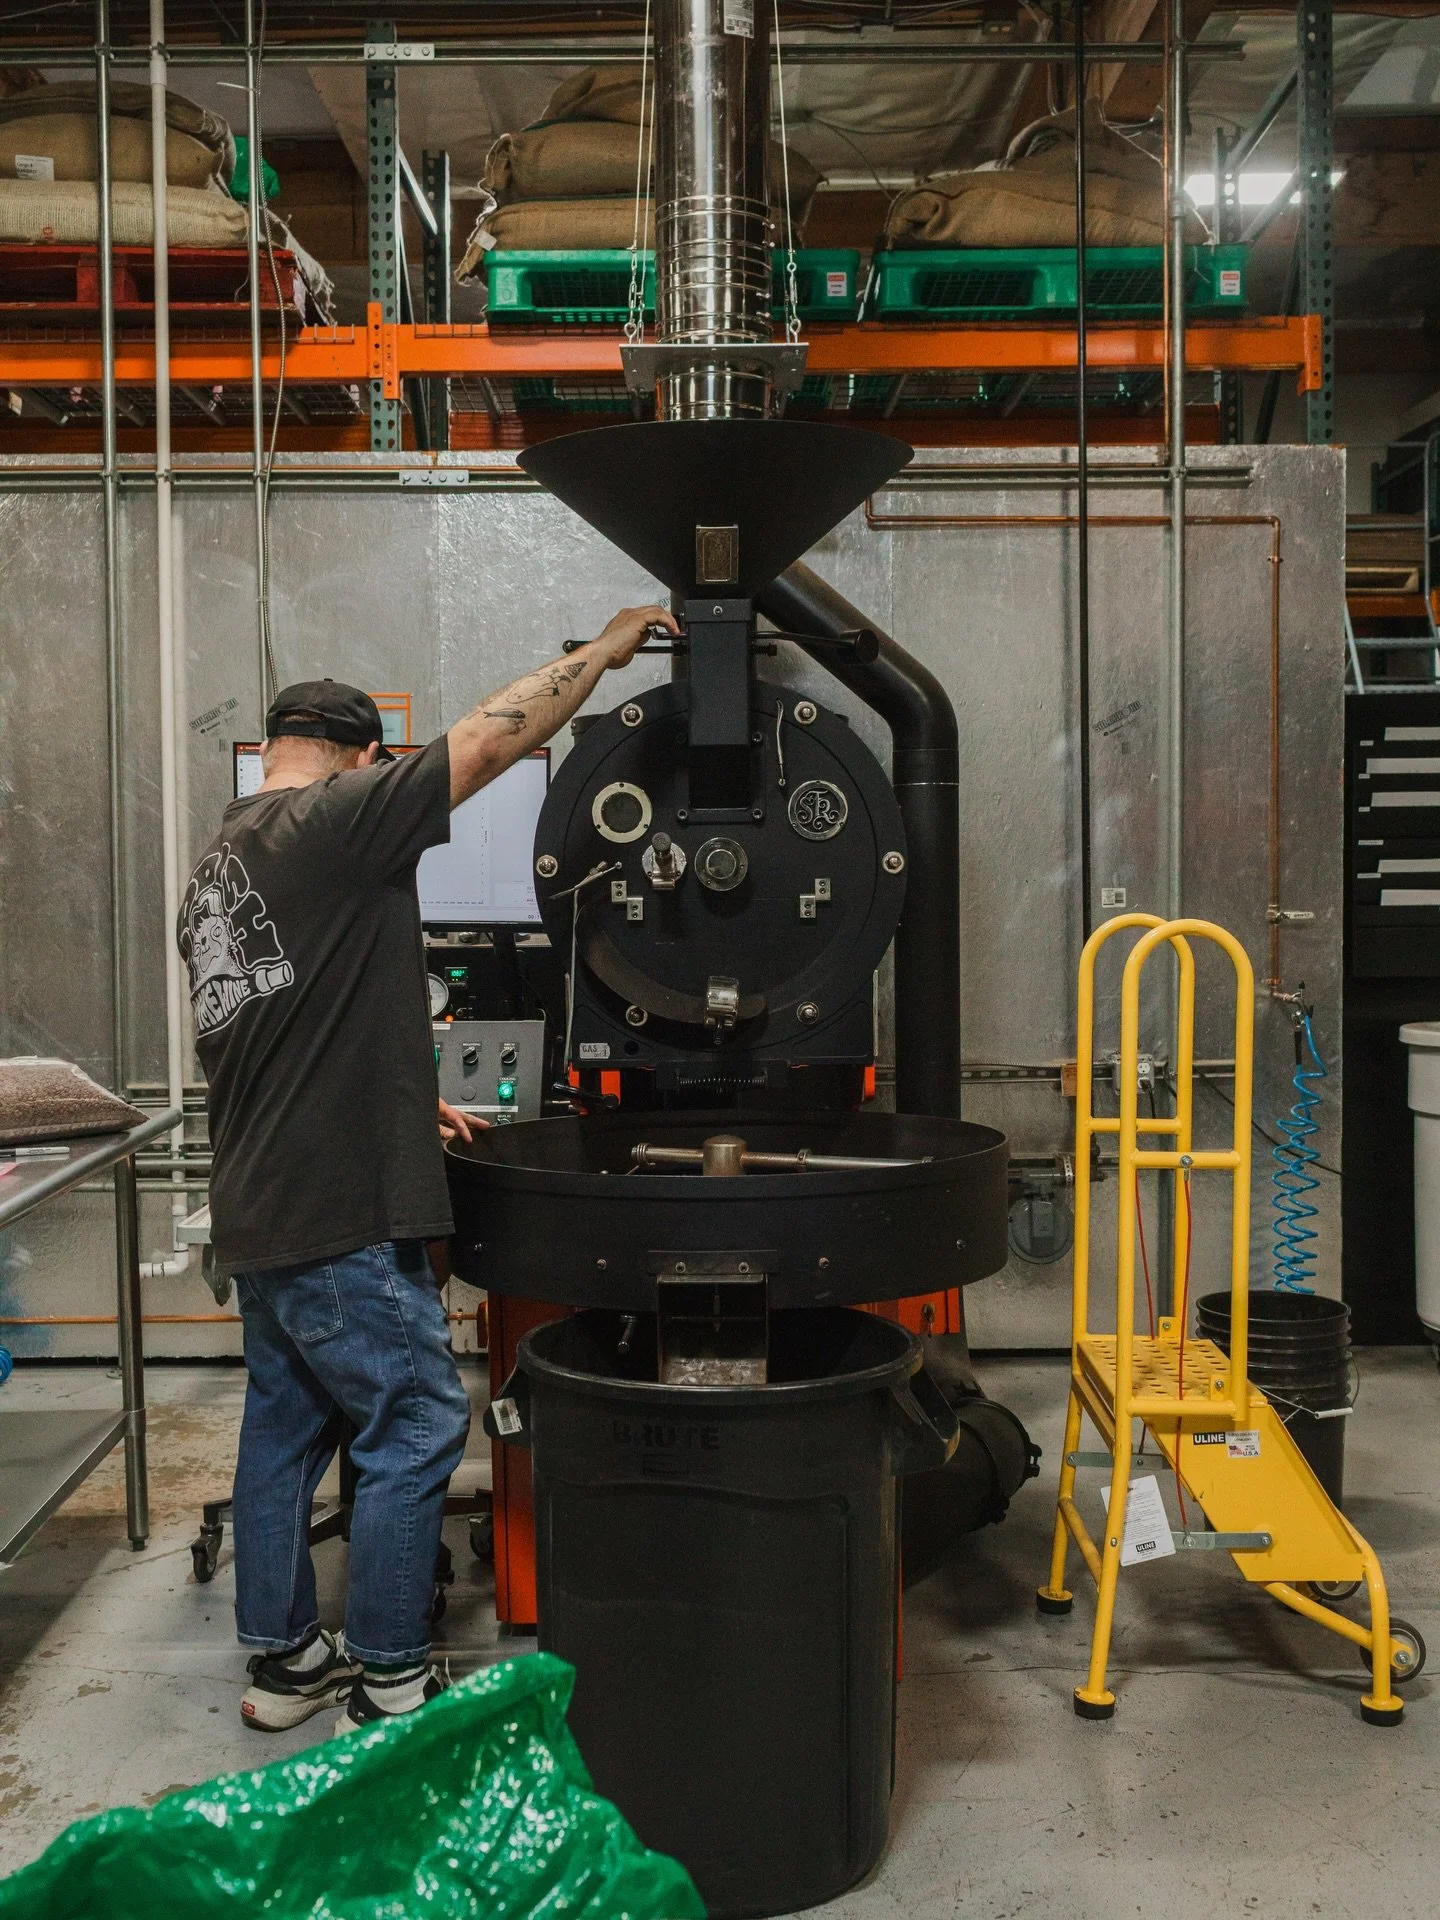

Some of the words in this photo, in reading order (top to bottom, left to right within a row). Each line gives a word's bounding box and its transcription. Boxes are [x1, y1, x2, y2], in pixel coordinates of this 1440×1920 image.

[613, 1421, 719, 1450] BRUTE
[1194, 1433, 1225, 1444] ULINE
[1137, 1542, 1156, 1552] ULINE
